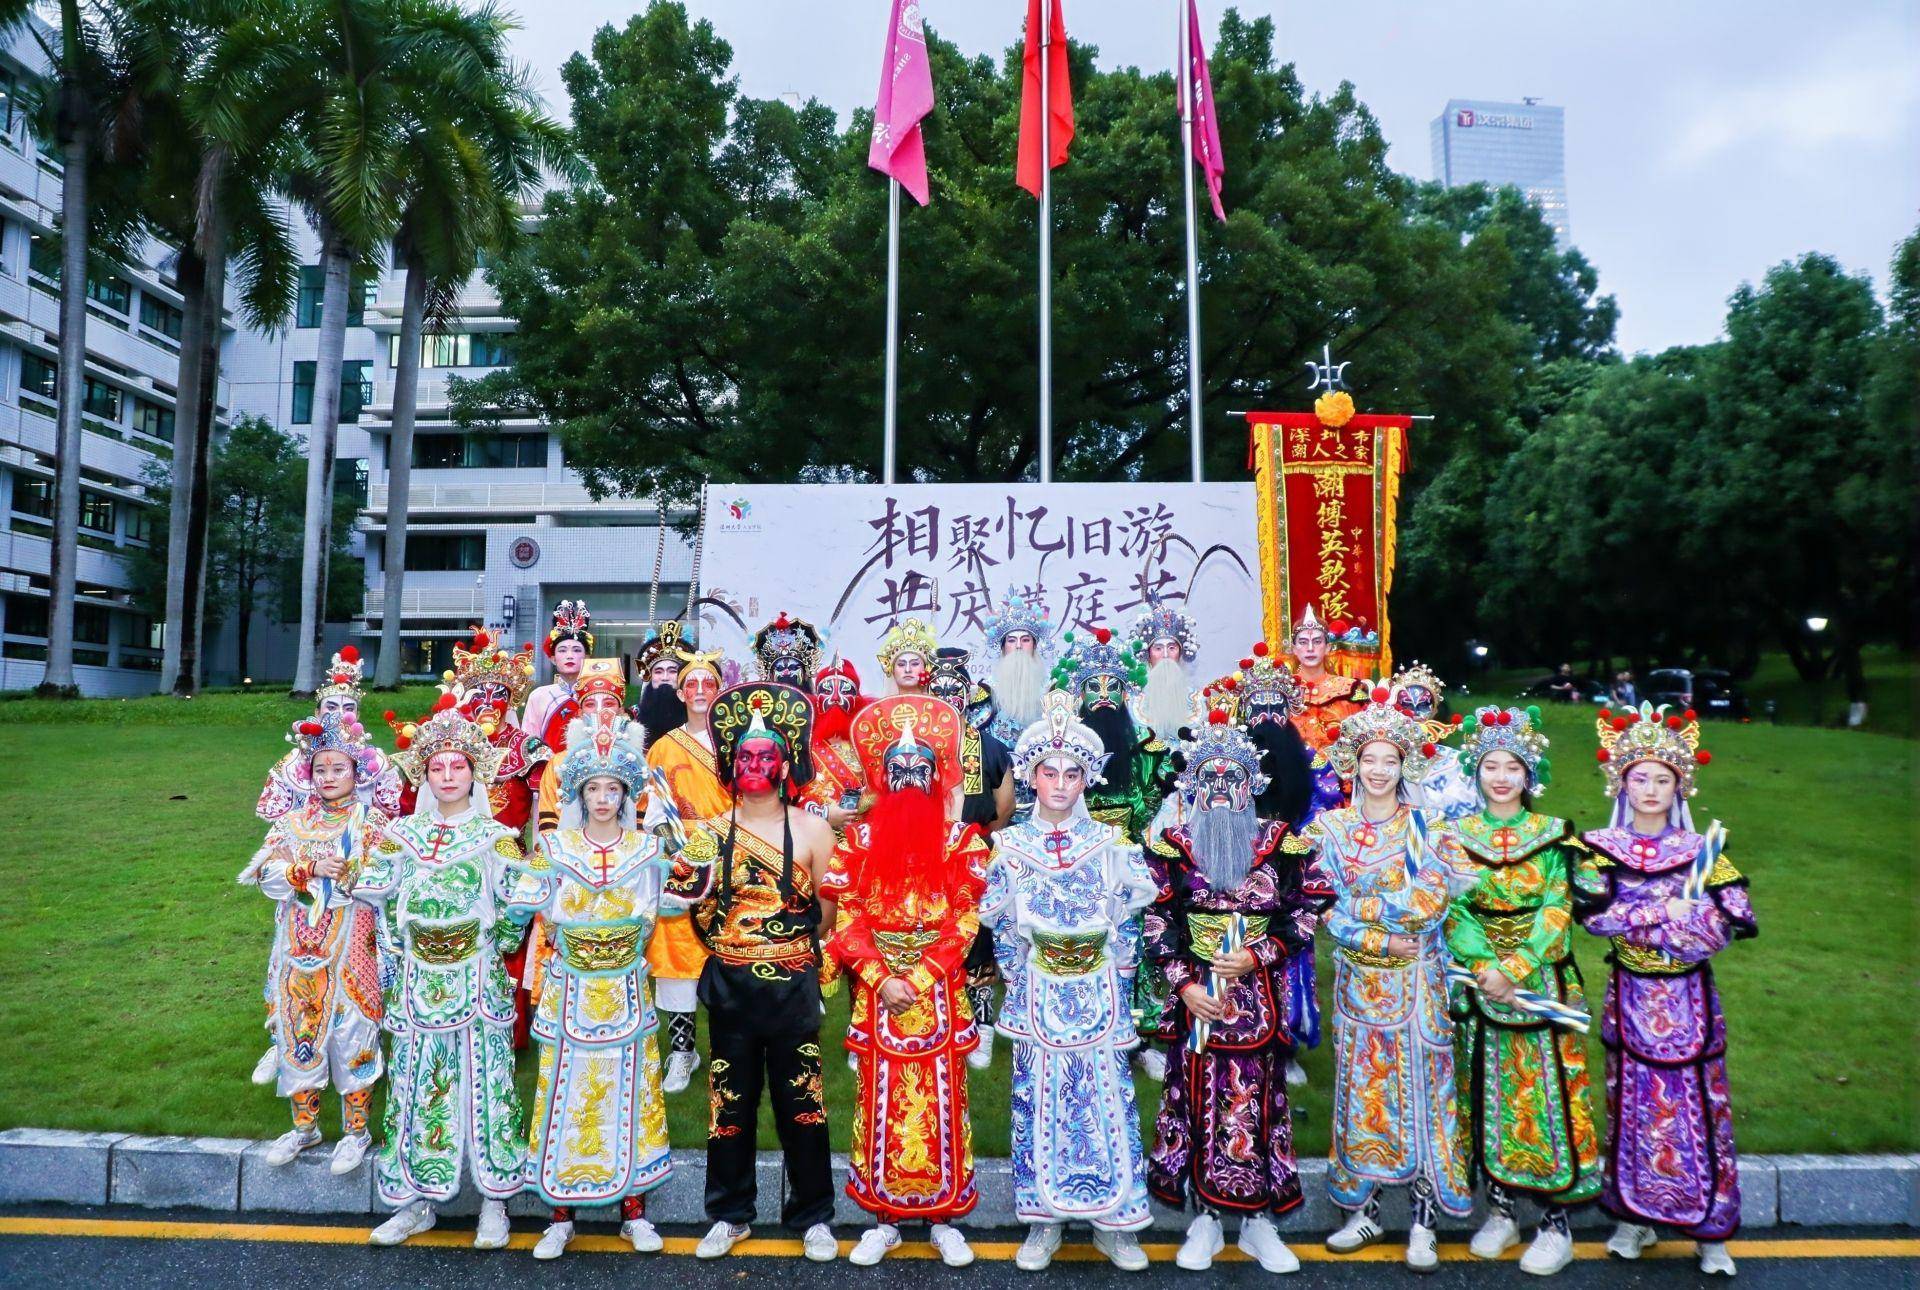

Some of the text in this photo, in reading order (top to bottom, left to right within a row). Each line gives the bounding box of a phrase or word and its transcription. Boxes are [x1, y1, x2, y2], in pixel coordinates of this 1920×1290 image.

[1289, 427, 1372, 445] 深圳市
[1291, 442, 1371, 461] 潮人之家
[863, 495, 1175, 572] 相聚忆旧游
